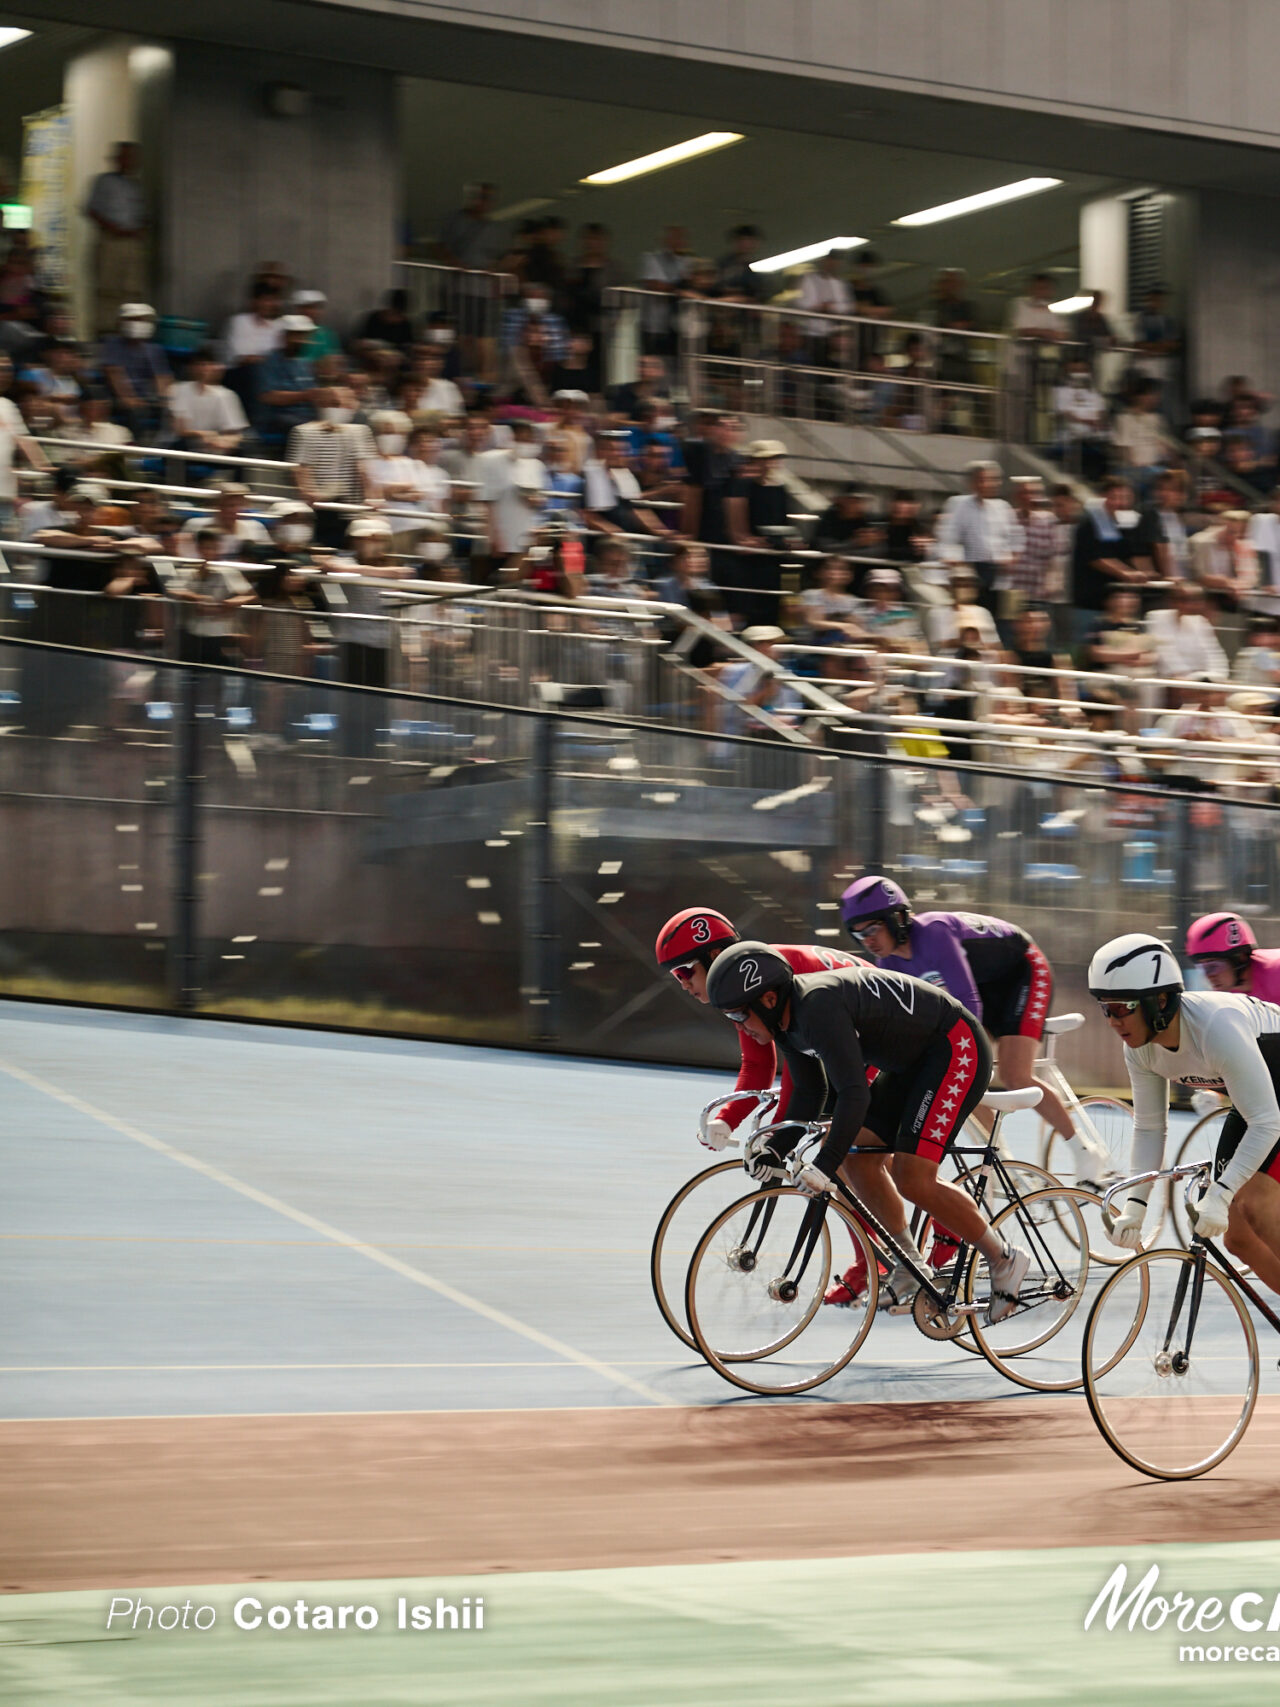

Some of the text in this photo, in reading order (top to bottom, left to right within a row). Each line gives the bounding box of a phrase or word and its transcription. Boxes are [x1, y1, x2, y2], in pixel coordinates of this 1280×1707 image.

[691, 916, 711, 943] 3
[1226, 921, 1243, 947] 8
[739, 958, 762, 992] 2
[857, 966, 915, 1015] 2
[1179, 1075, 1225, 1085] KEIRIN
